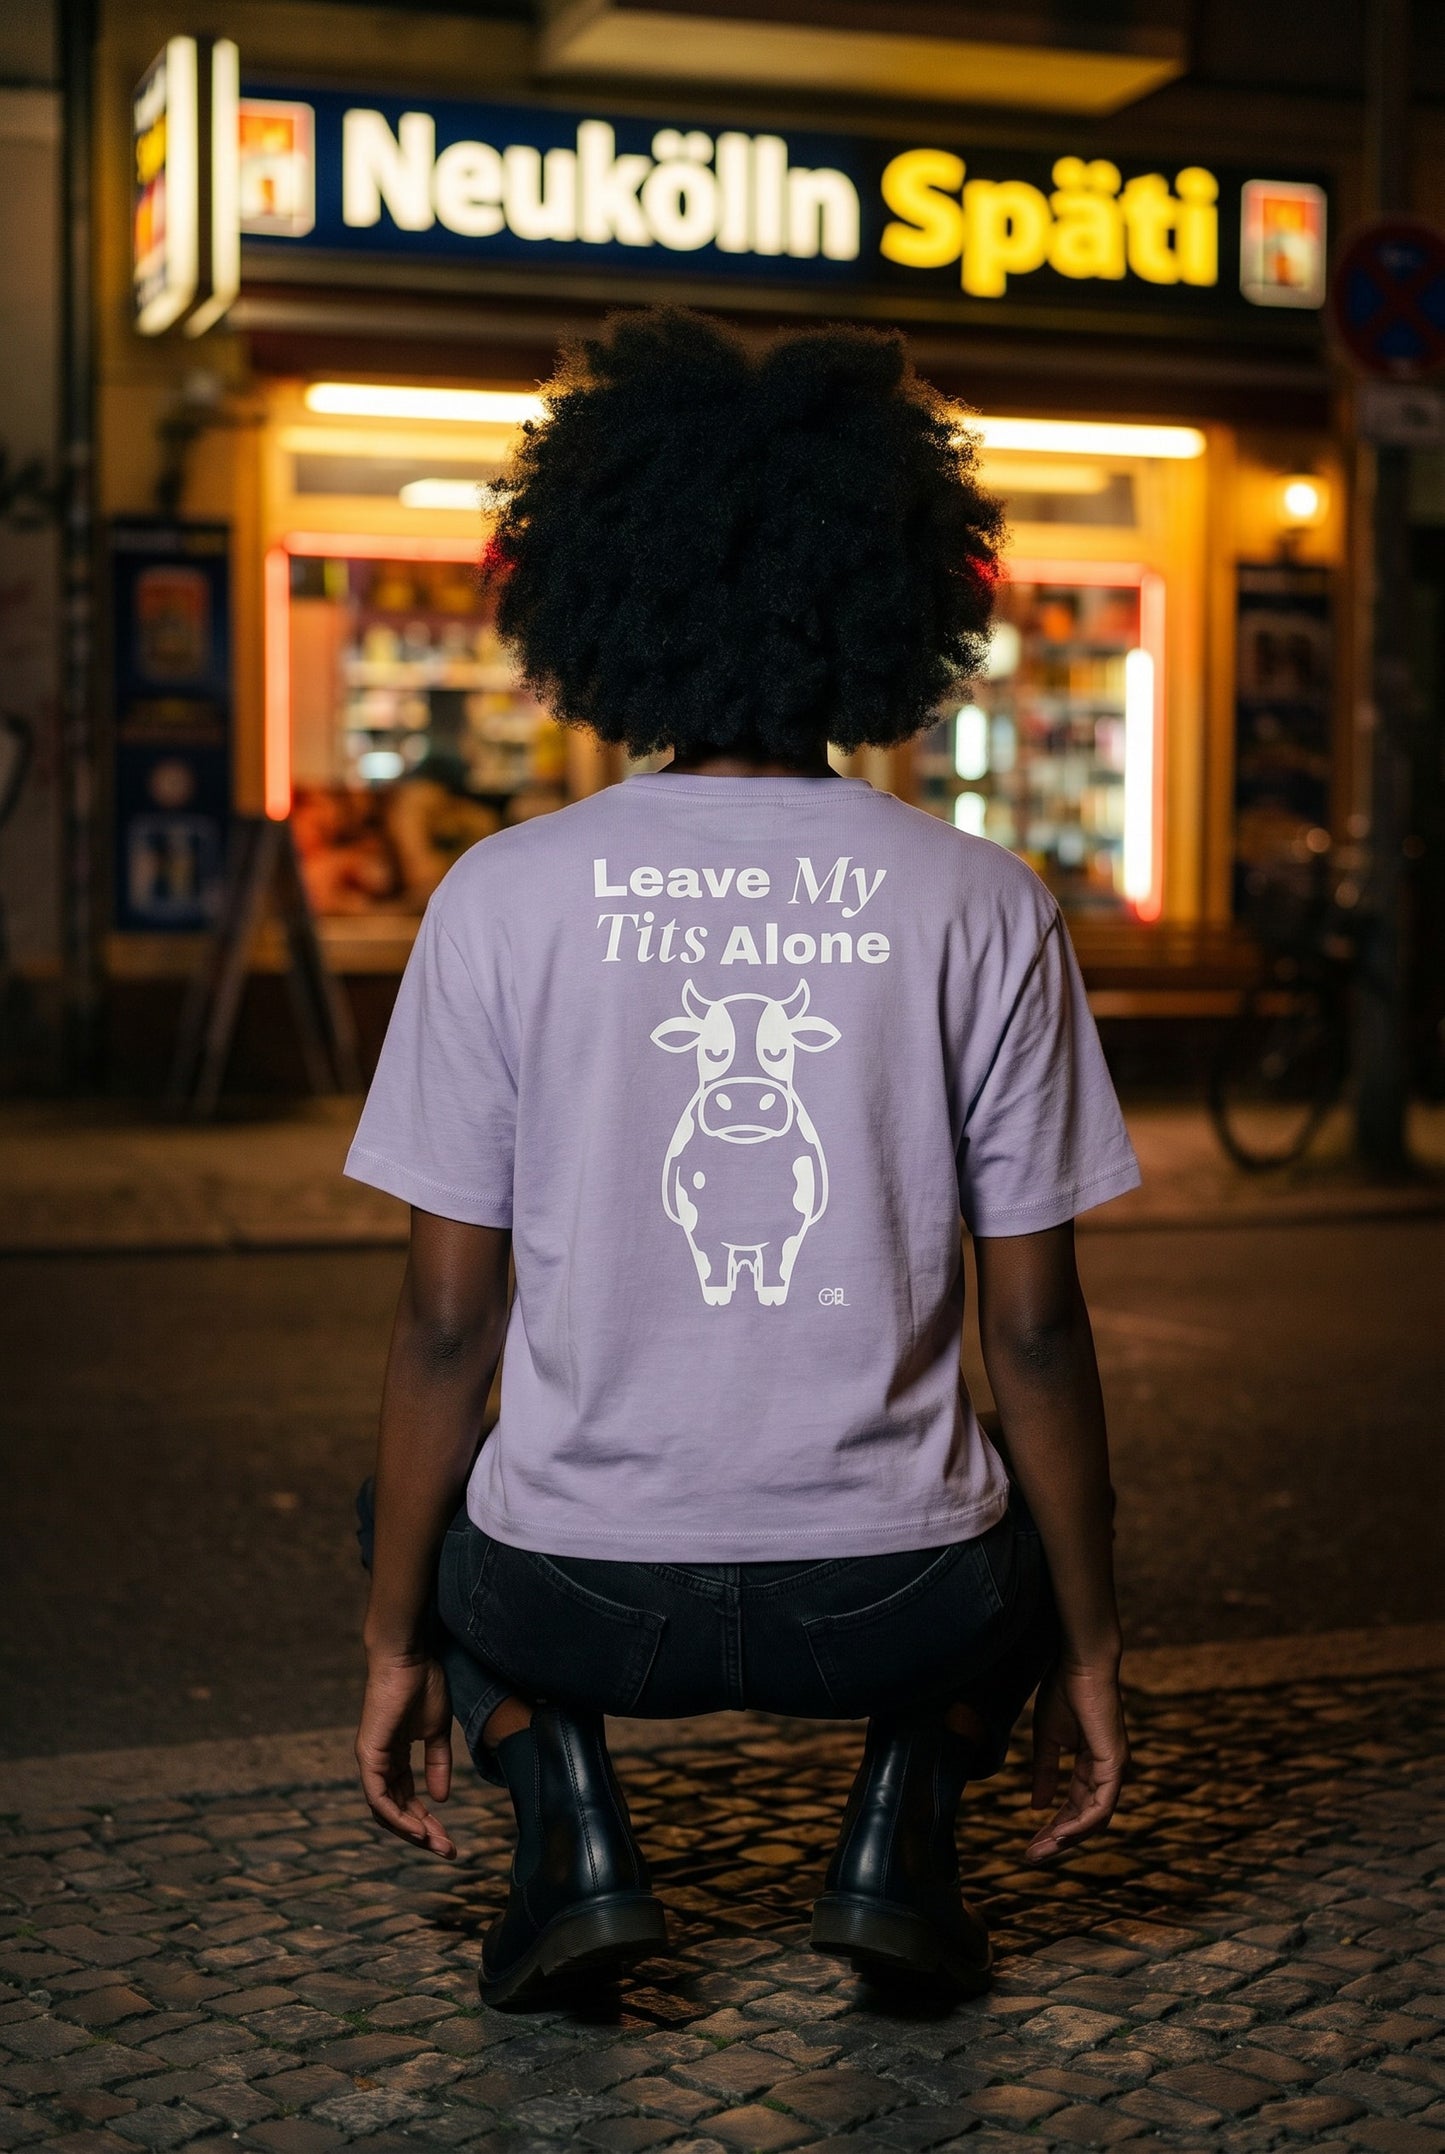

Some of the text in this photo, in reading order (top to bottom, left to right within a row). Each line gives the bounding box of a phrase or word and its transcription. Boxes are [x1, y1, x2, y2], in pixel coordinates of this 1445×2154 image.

[341, 107, 861, 262] Neukölln
[880, 148, 1220, 298] Späti
[593, 856, 888, 919] Leave My
[596, 911, 891, 965] Tits Alone
